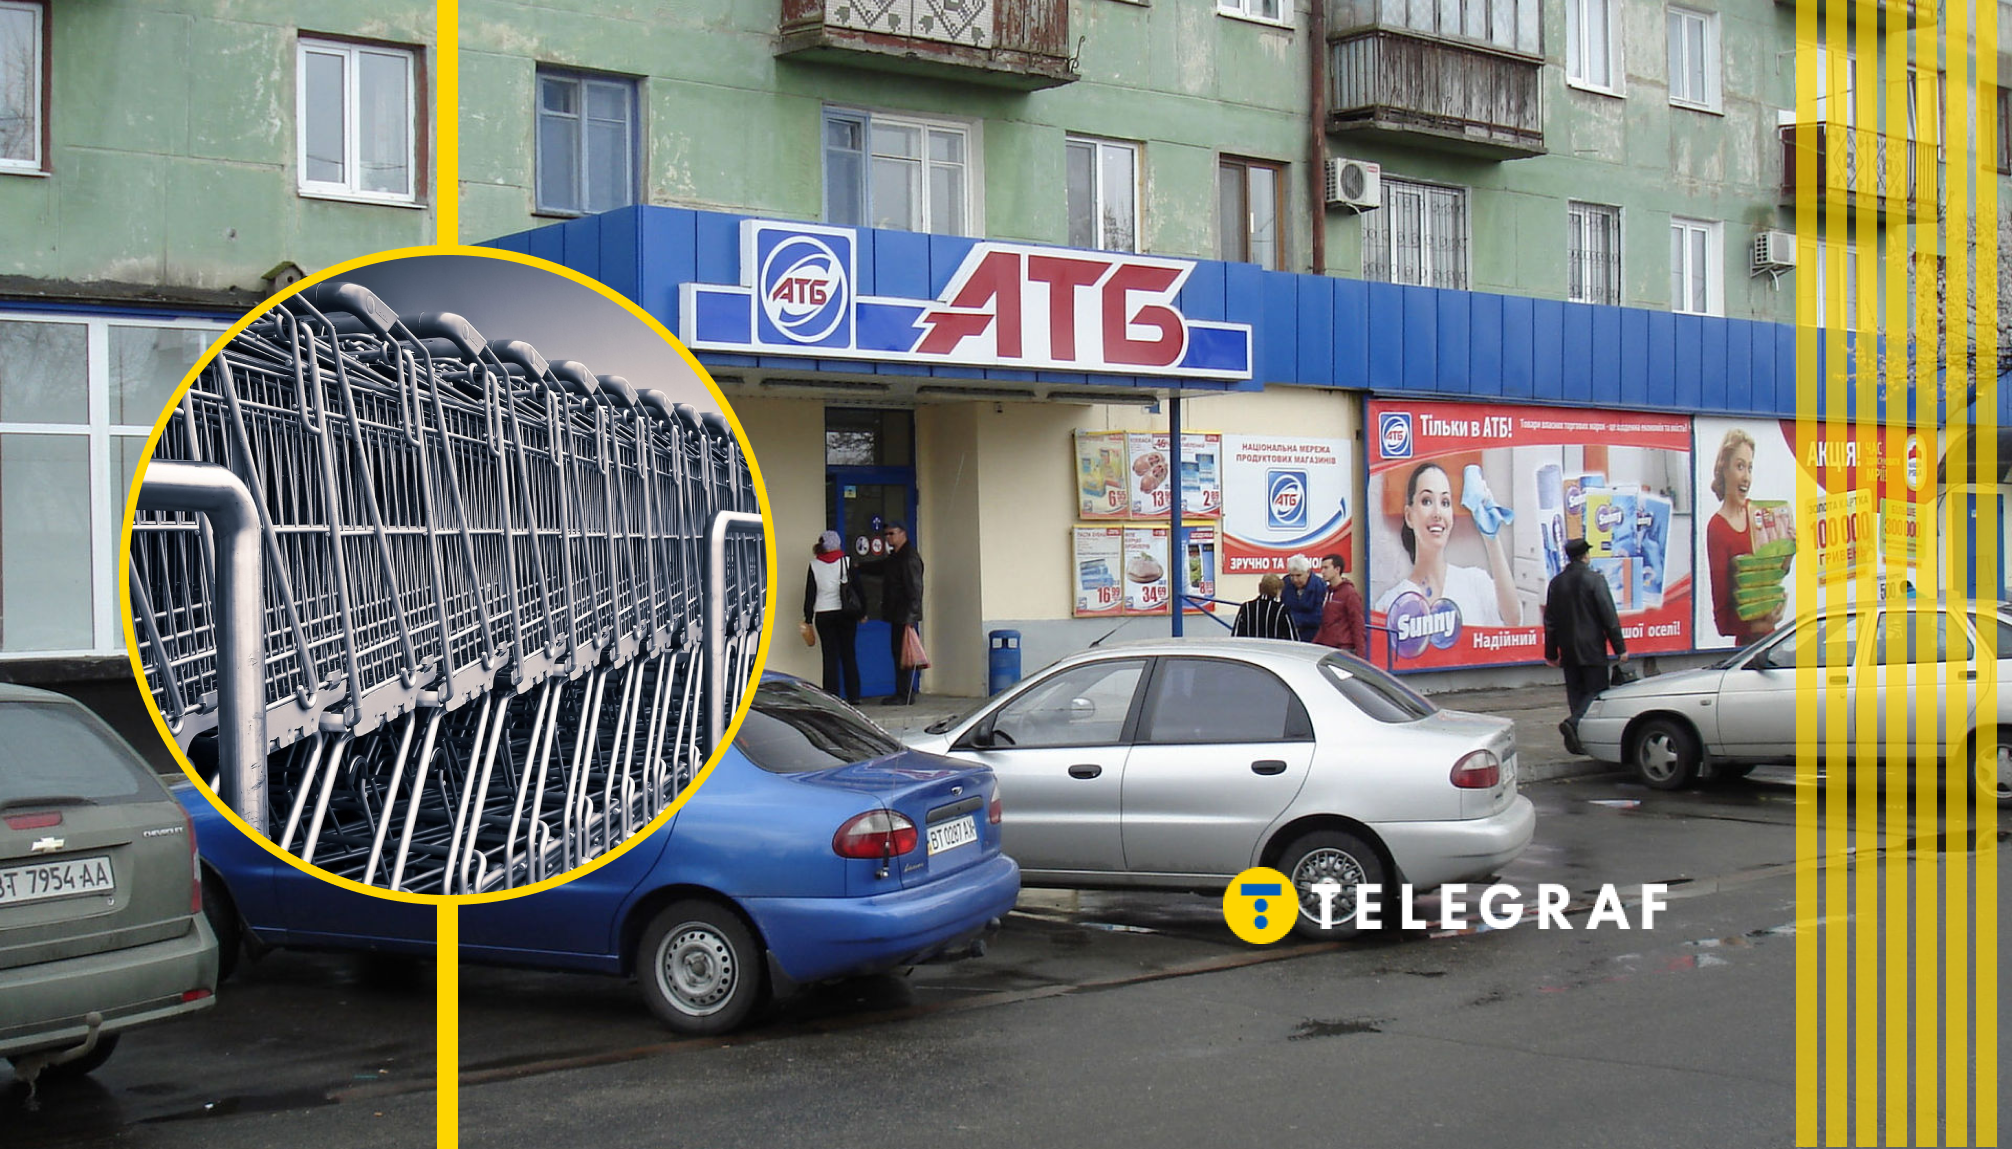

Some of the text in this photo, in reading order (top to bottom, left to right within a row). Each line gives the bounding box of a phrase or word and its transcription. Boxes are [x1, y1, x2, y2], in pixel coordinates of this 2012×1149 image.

[772, 277, 827, 304] АТБ
[917, 251, 1185, 367] АТБ
[1385, 430, 1404, 441] АТБ
[1420, 414, 1513, 438] Тільки в АТБ!
[1242, 443, 1330, 454] НАЦІОНАЛЬНА МЕРЕЖА
[1806, 441, 1861, 472] АКЦІЯ!
[1236, 454, 1336, 465] ПРОДУКТОВИХ МАГАЗИНІВ
[1274, 493, 1298, 506] АТБ
[1808, 495, 1869, 514] ЗОЛОТА КАРТКА
[1810, 511, 1870, 549] 100 000
[1230, 557, 1269, 570] ЗРУЧНО
[1272, 558, 1284, 569] ТА
[1819, 547, 1866, 565] ГРИВЕНЬ
[1097, 586, 1110, 603] 16
[1142, 586, 1157, 603] 34
[1397, 609, 1456, 641] Sunny
[1473, 620, 1680, 650] Надійний шої оселі!
[26, 866, 75, 894] 7954
[82, 861, 109, 888] AA
